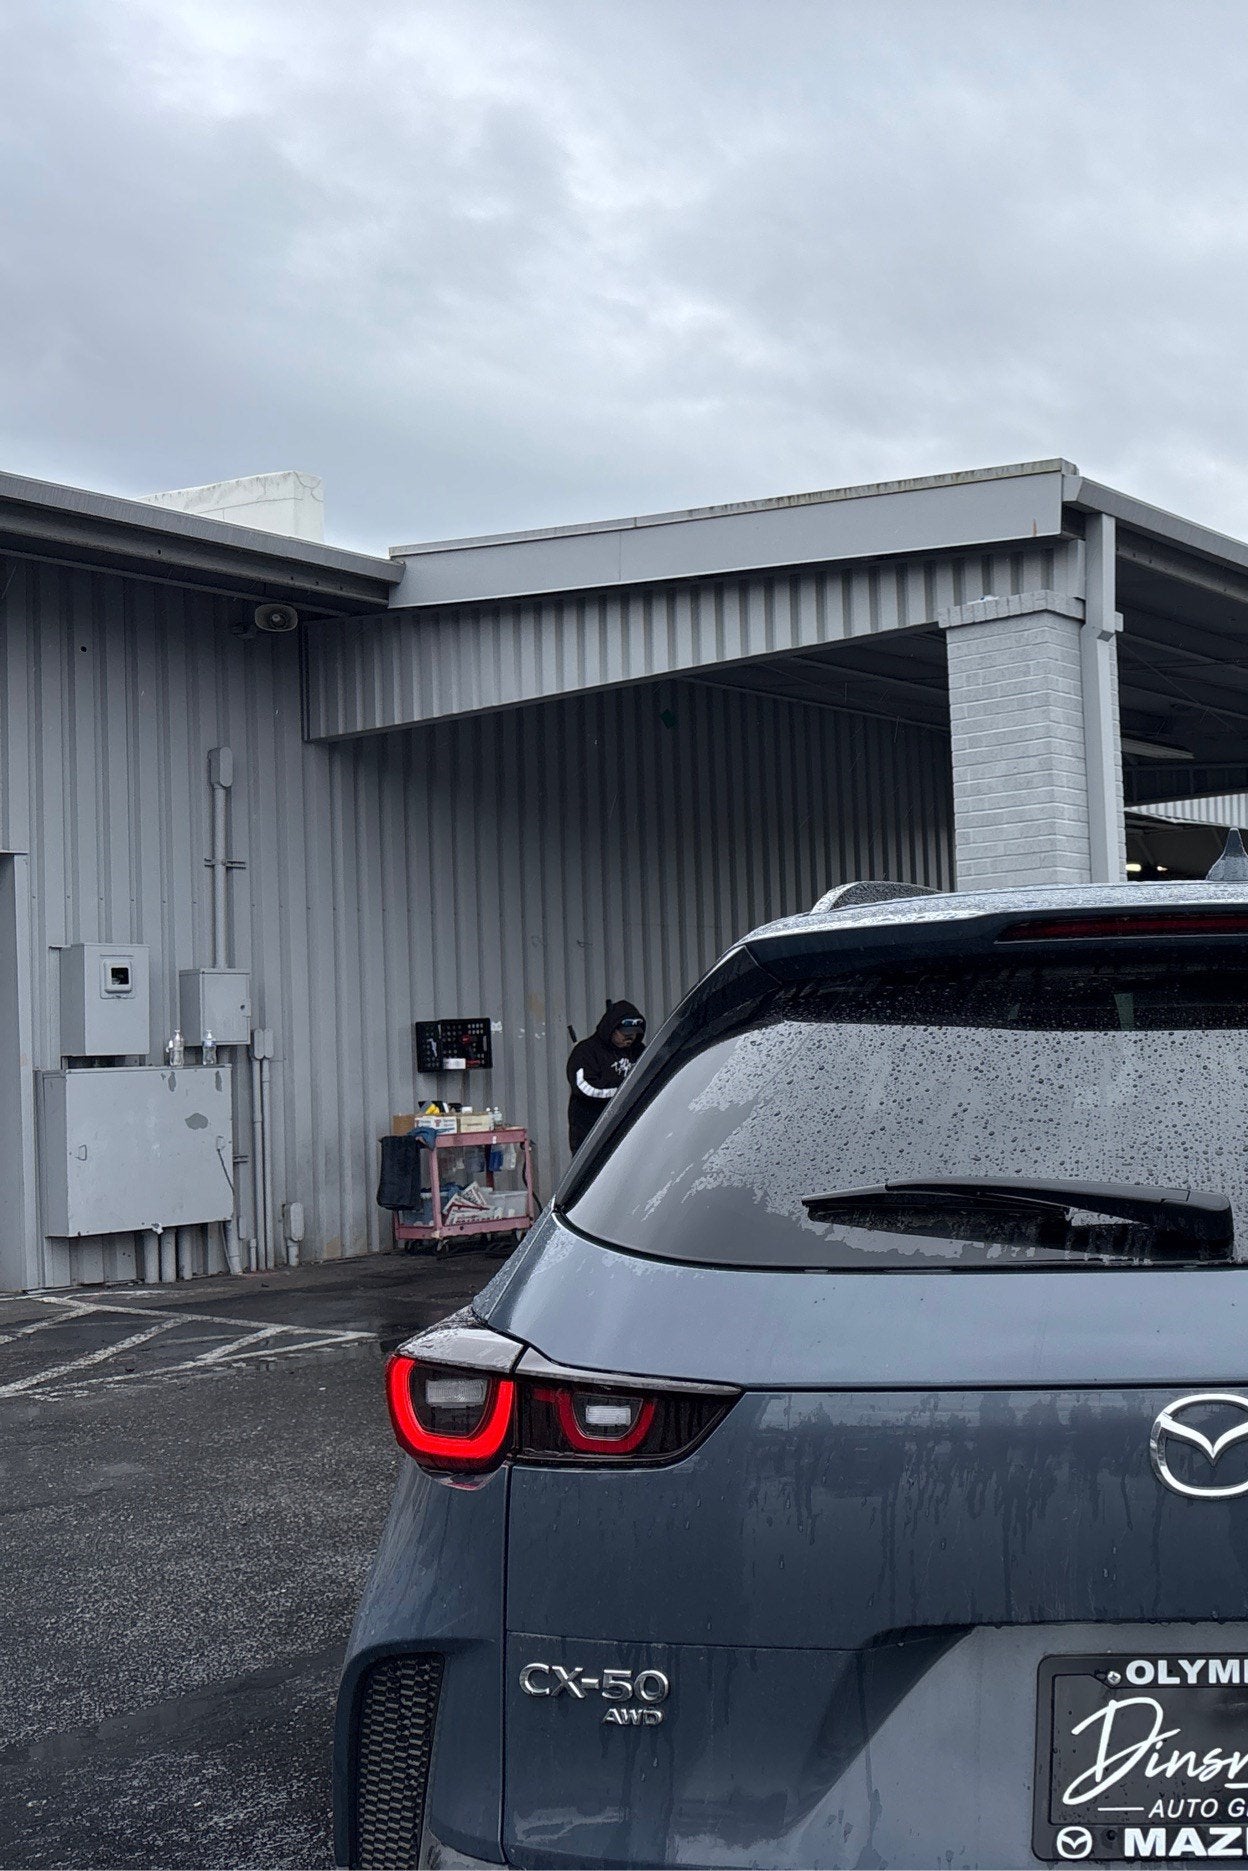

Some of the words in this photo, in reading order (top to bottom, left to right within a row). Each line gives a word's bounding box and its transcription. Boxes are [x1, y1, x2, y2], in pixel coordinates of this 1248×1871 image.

[518, 1662, 670, 1703] CX-50
[602, 1707, 665, 1726] AWD
[1148, 1798, 1220, 1819] AUTO
